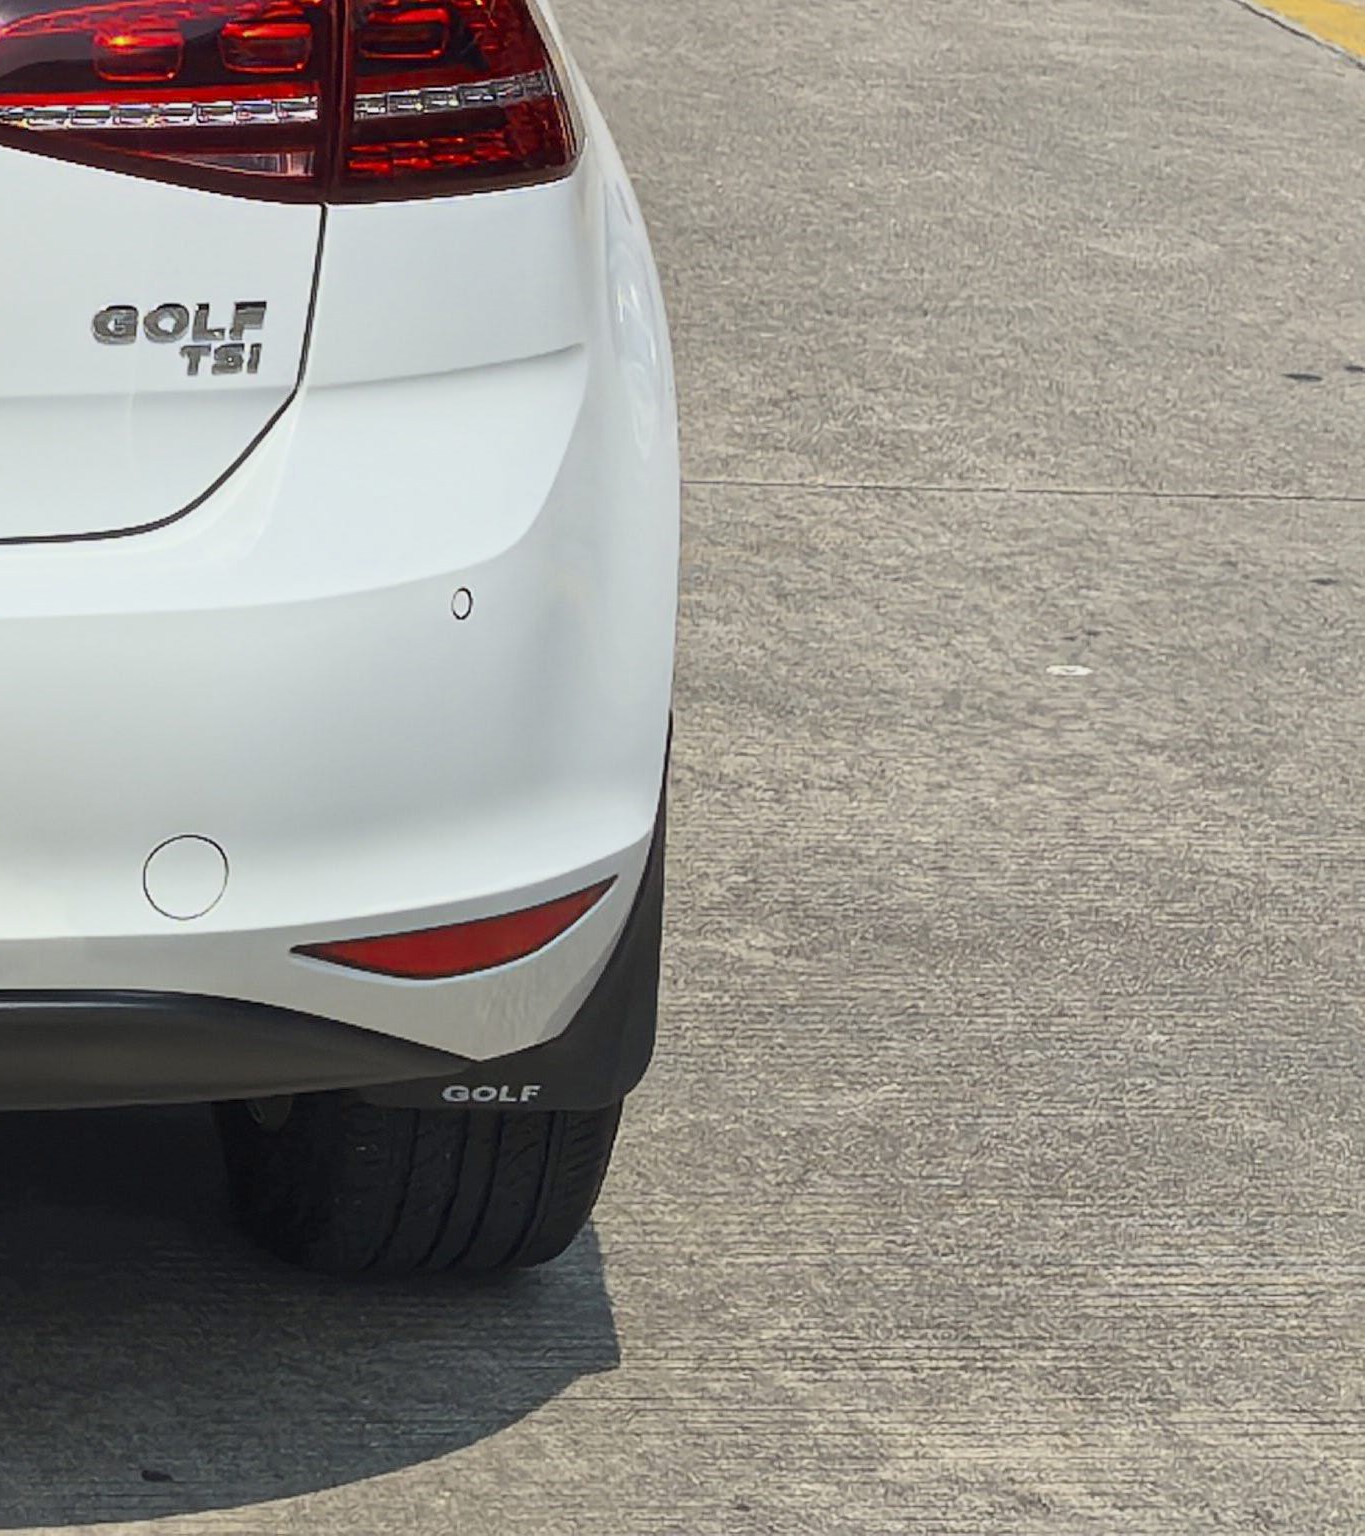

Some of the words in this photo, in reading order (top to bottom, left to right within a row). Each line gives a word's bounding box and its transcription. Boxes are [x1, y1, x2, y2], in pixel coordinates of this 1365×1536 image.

[92, 301, 268, 345] GOLF
[180, 343, 263, 376] TSI
[441, 1085, 542, 1102] GOLF
